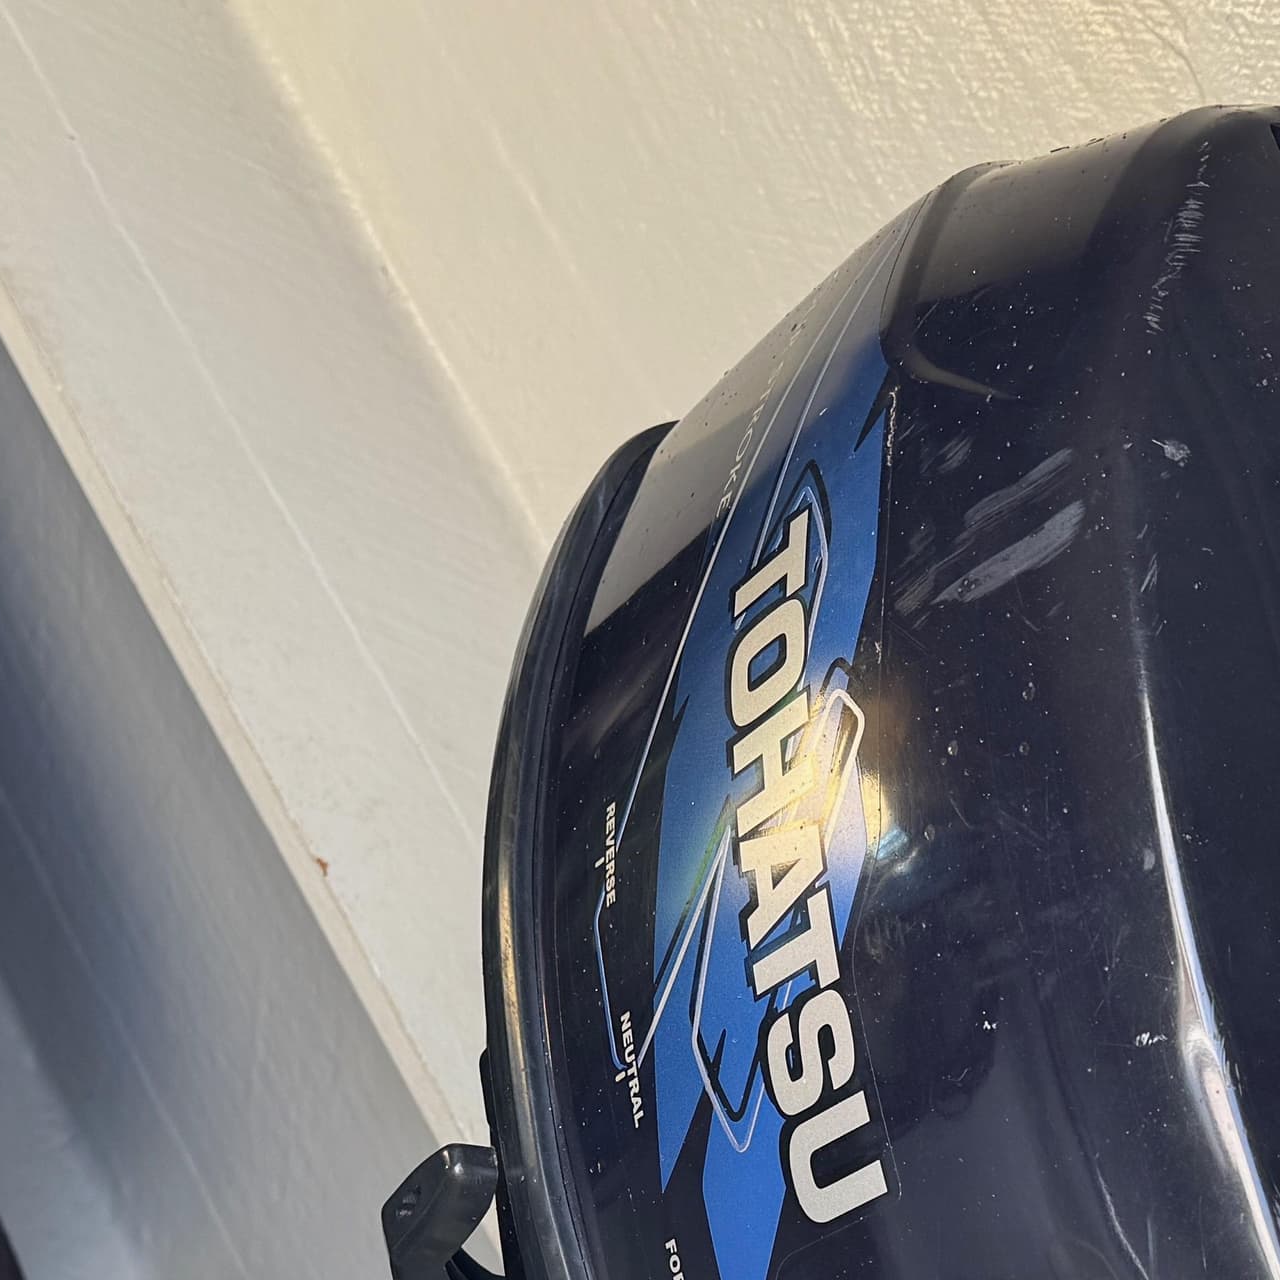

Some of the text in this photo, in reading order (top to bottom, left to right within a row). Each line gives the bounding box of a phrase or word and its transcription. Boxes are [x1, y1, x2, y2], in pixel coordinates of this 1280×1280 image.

[605, 801, 616, 908] REVERSE
[729, 510, 888, 1225] TOHATSU
[620, 1011, 645, 1129] NEUTRAL
